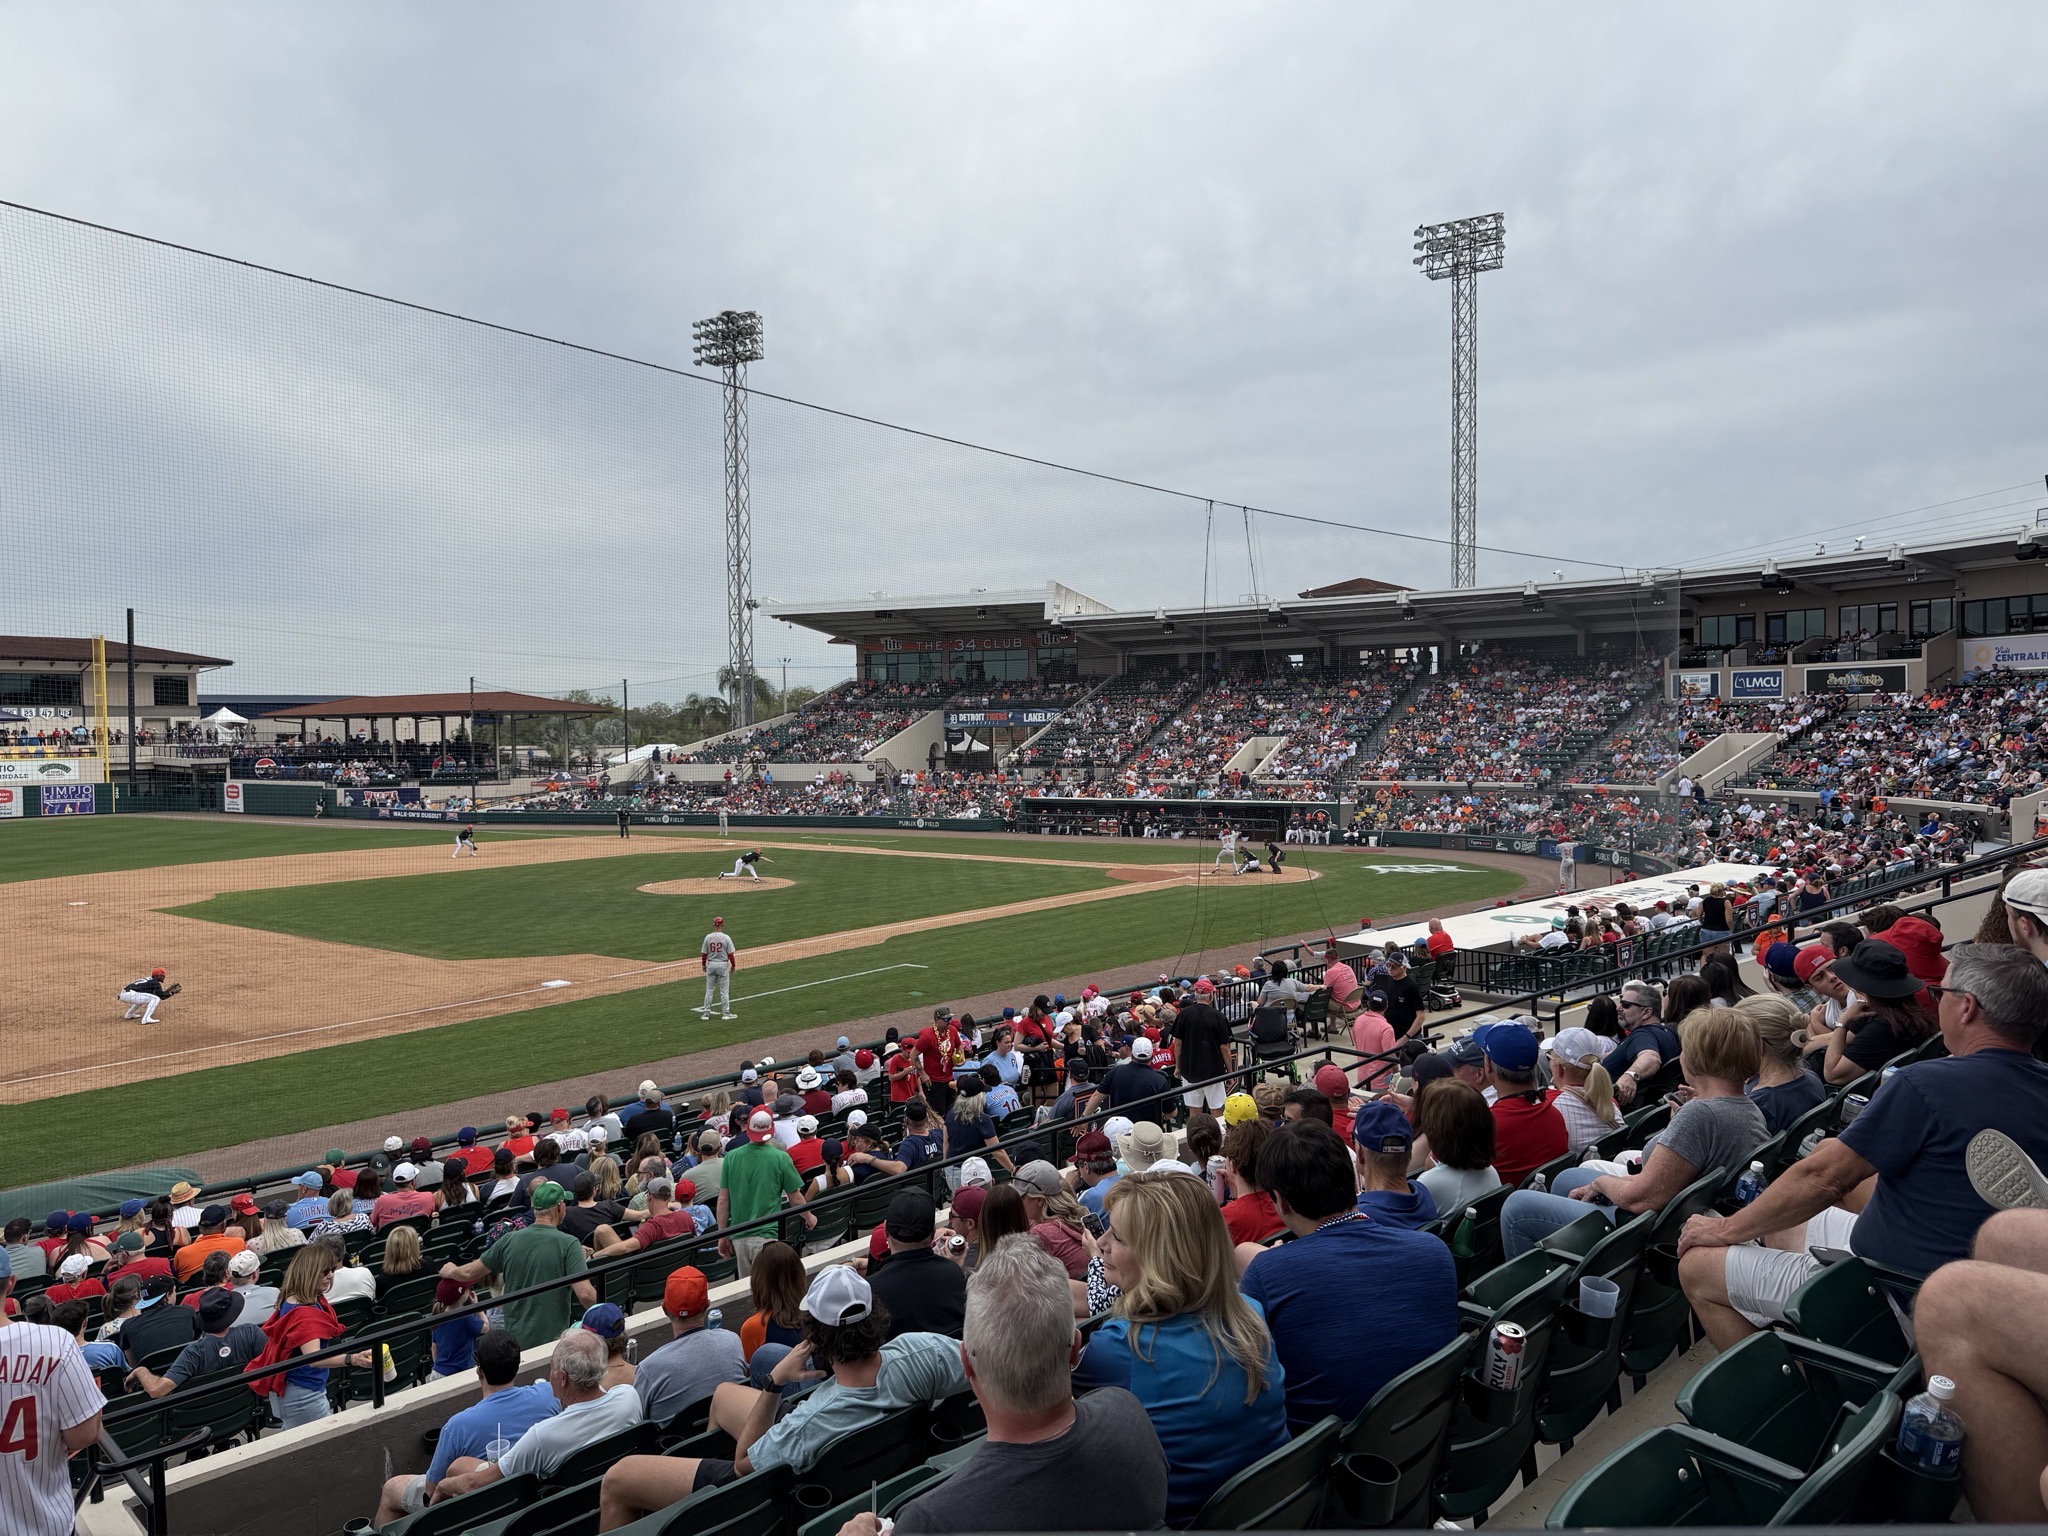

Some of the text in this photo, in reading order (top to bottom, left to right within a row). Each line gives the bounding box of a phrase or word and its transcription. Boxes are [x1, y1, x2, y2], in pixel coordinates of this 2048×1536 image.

[880, 637, 902, 653] Lite
[916, 641, 943, 651] THE
[983, 638, 1022, 649] CLUB
[1995, 645, 2010, 655] Visit
[1995, 652, 2040, 662] CENTRAL
[1746, 676, 1780, 688] LMCU
[24, 710, 34, 718] 23
[41, 710, 53, 718] 47
[959, 712, 1008, 721] DETROIT TIGERS
[43, 786, 92, 796] LIMPIO
[392, 810, 421, 818] WALK-ON'S
[421, 812, 443, 820] DUGOUT
[644, 816, 662, 824] PUBLIX
[1620, 856, 1631, 866] FIEL
[710, 942, 723, 953] 62
[1621, 951, 1629, 960] 110
[1152, 1052, 1172, 1065] HARPER
[1002, 1098, 1020, 1112] 10
[1490, 1353, 1508, 1390] RULY
